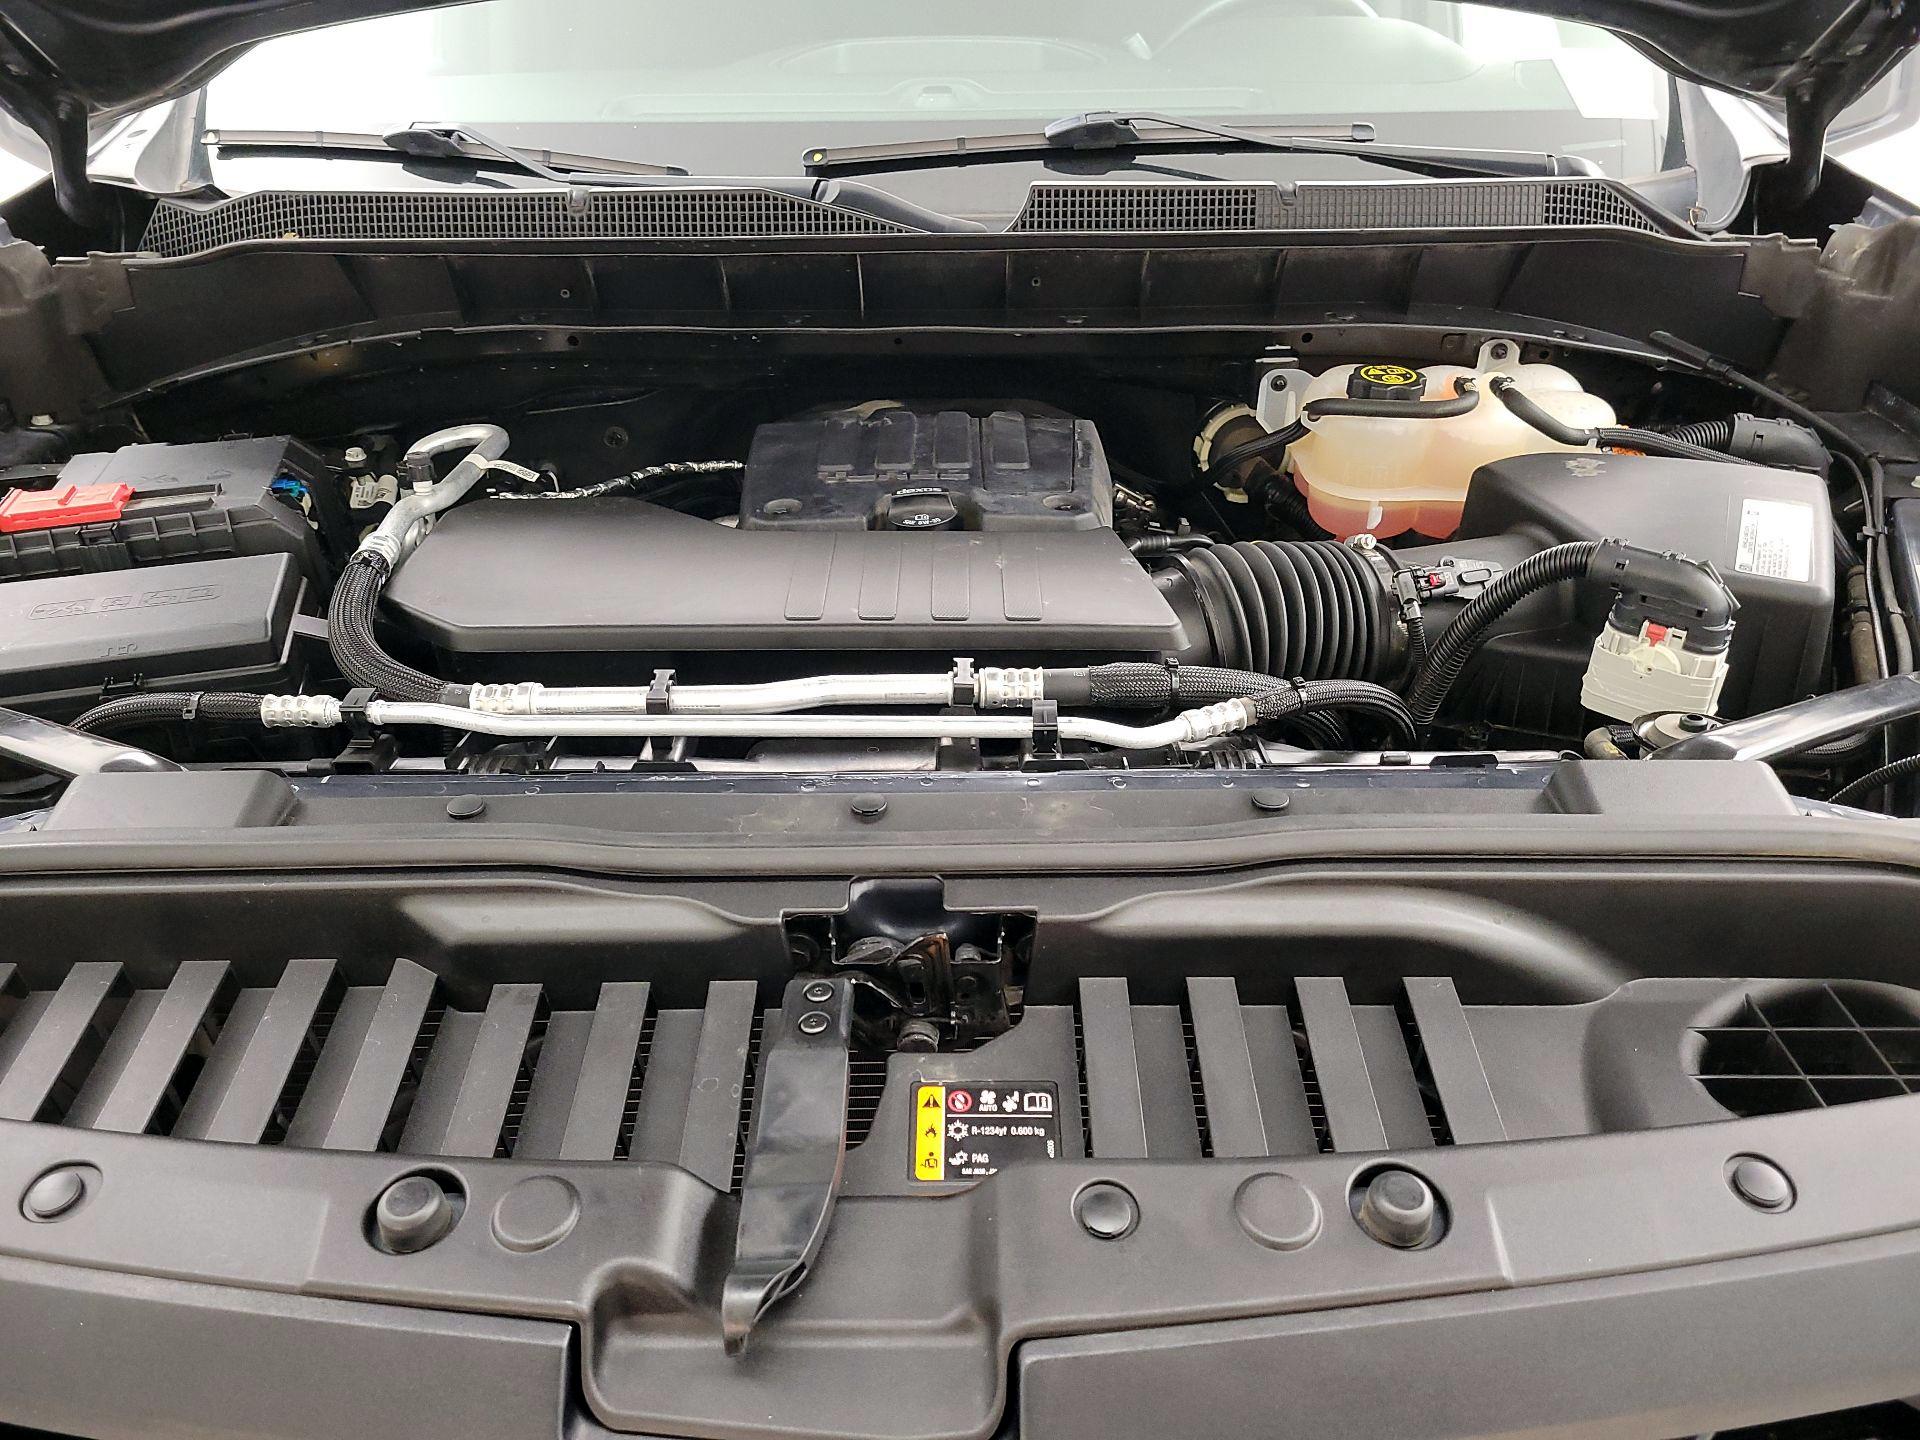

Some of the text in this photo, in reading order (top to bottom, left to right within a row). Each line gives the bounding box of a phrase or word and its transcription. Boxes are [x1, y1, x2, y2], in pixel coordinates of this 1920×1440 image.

[978, 1103, 998, 1112] AUTO
[1034, 1126, 1045, 1136] kg
[971, 1153, 989, 1163] PAG
